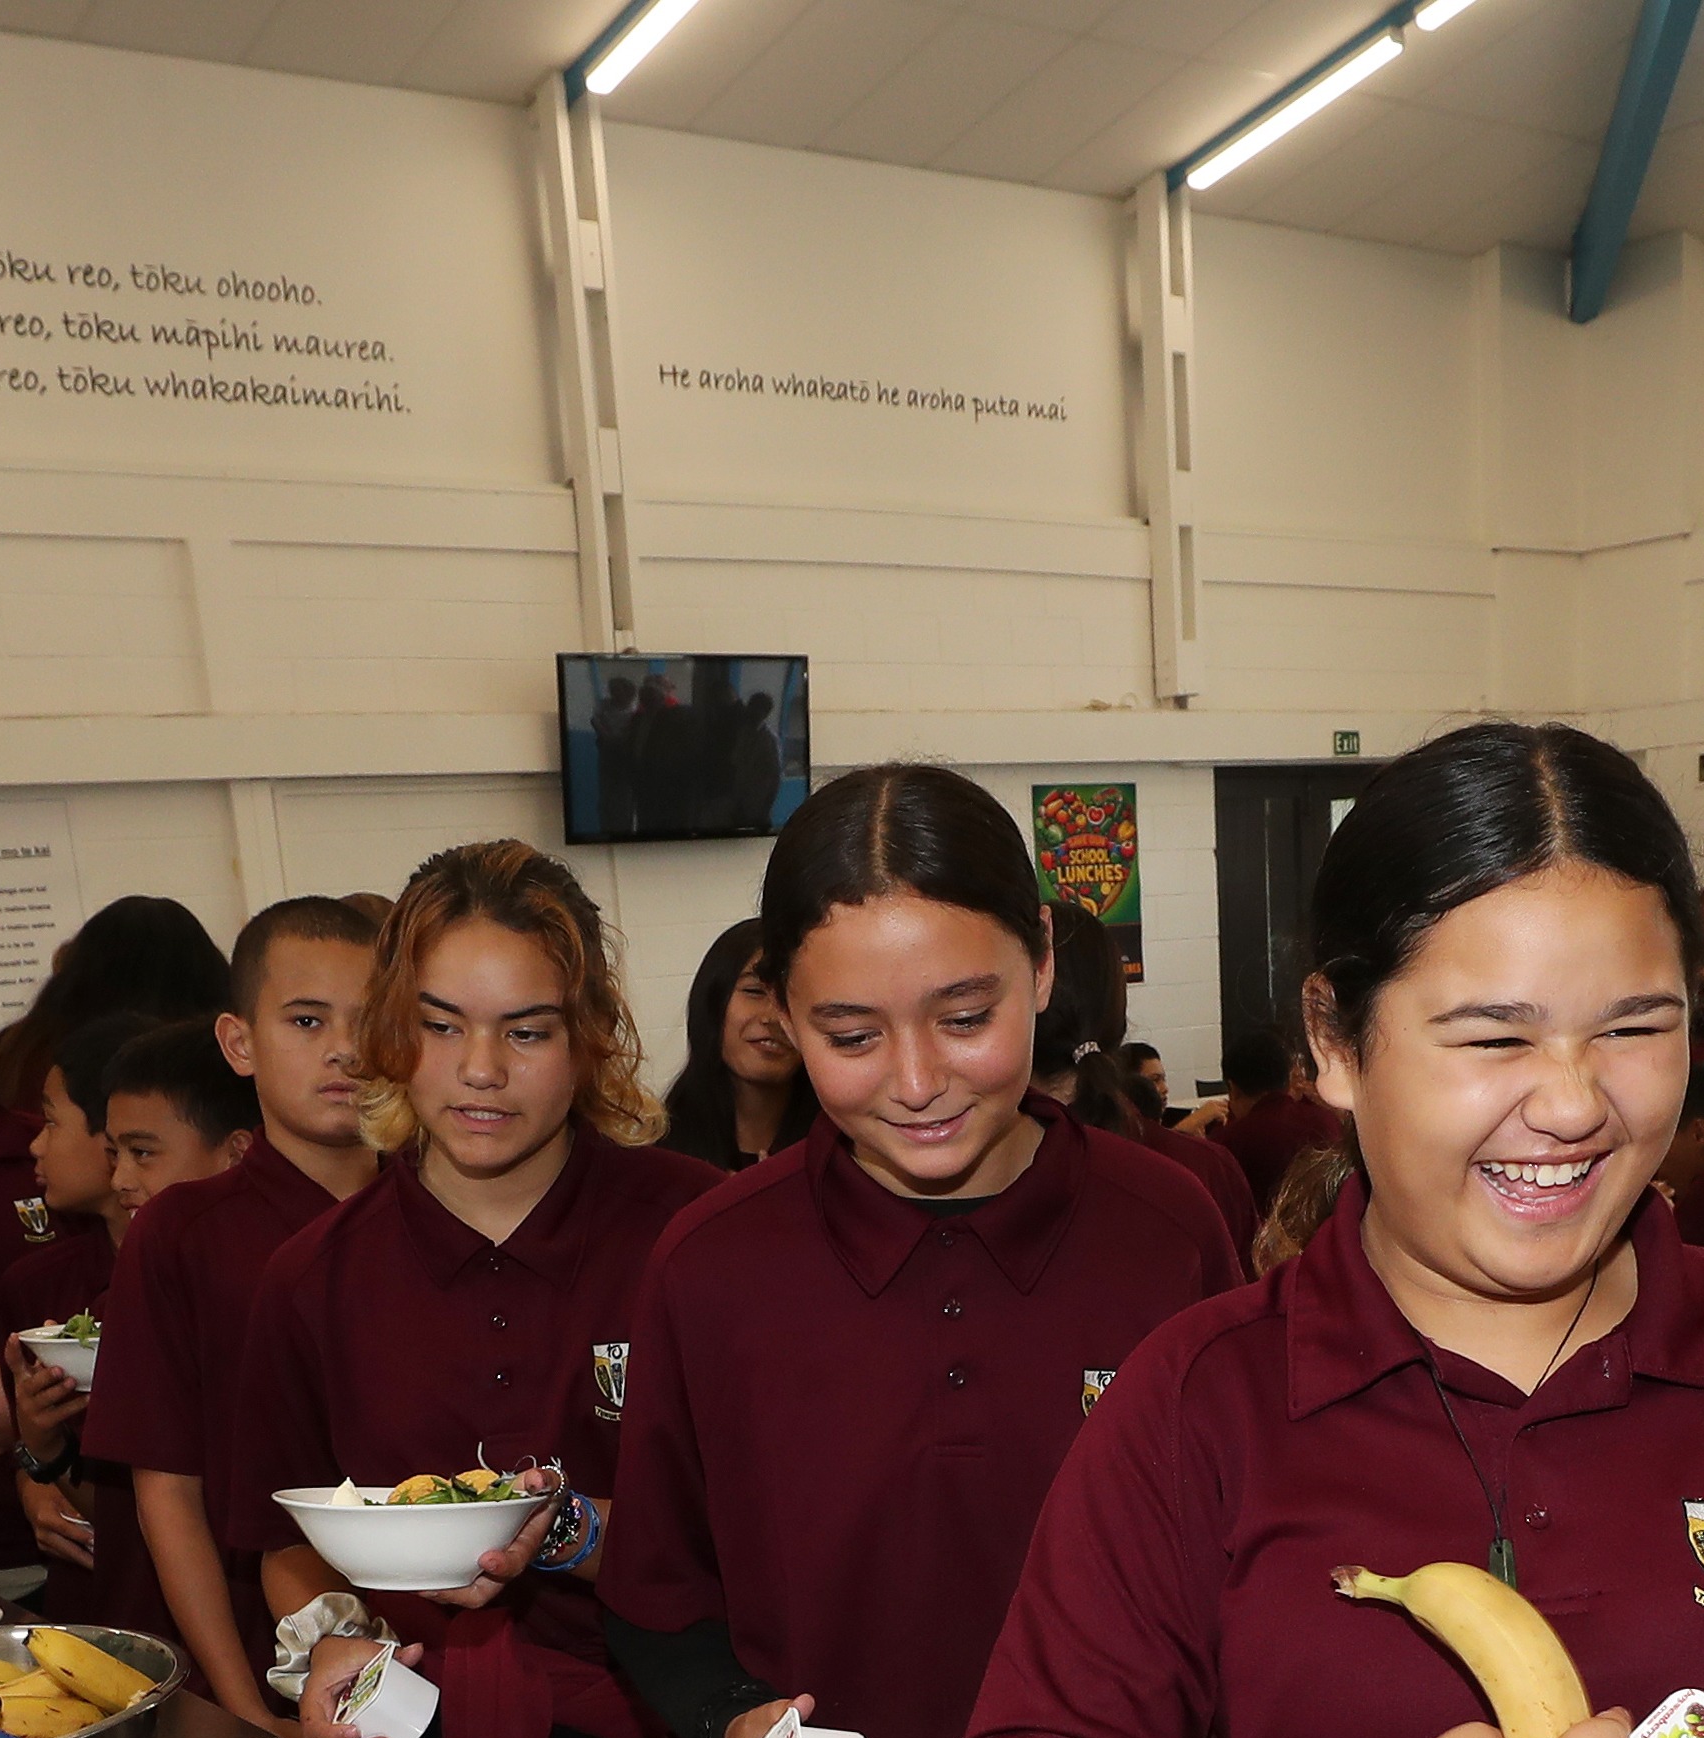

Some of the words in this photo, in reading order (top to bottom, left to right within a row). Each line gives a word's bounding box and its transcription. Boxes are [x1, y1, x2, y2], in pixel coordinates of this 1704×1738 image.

[68, 263, 120, 292] reo,
[130, 262, 206, 295] tōku
[217, 270, 323, 306] ohooho.
[62, 310, 141, 344] tōku
[151, 318, 263, 362] māpihi
[273, 333, 395, 363] maurea.
[58, 364, 135, 396] tōku
[144, 369, 412, 414] whakakaimarihi.
[659, 364, 692, 391] He
[699, 368, 766, 395] aroha
[772, 373, 872, 405] whakatō
[877, 380, 901, 409] he
[907, 388, 967, 414] aroha
[972, 396, 1021, 425] puta
[1027, 395, 1069, 423] mai
[1057, 863, 1124, 884] LUNCHES
[1068, 848, 1110, 865] SCHOOL
